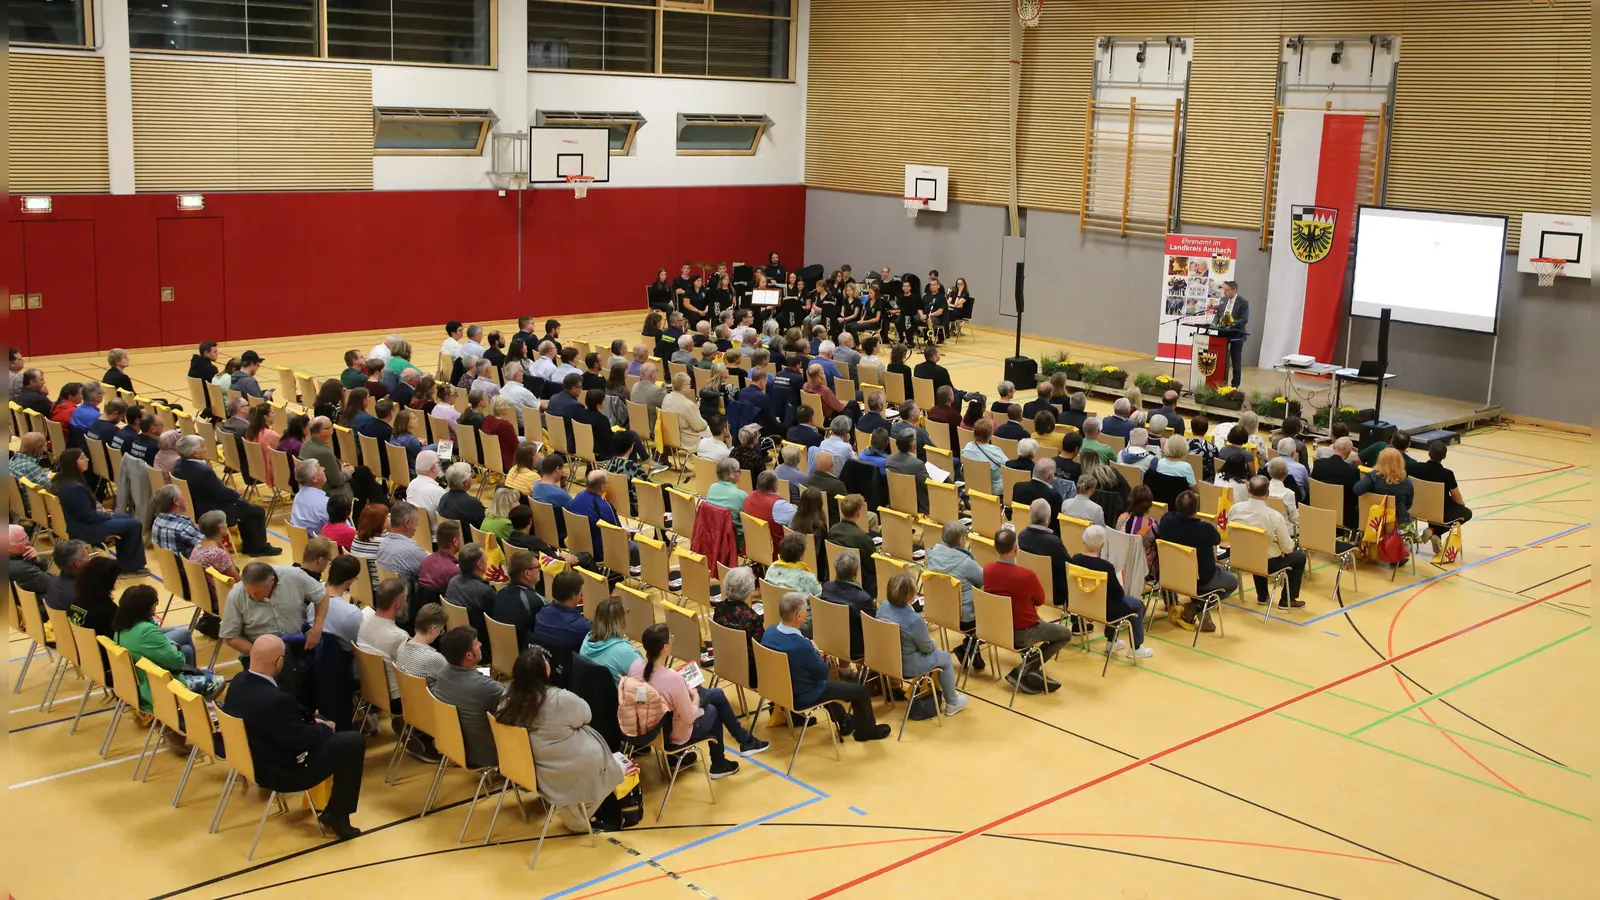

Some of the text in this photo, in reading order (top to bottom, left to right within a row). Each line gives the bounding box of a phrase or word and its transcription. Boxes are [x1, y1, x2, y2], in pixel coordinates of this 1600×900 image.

[1181, 237, 1212, 246] Ehrenamt
[1169, 244, 1232, 254] Landkreis Ansbach
